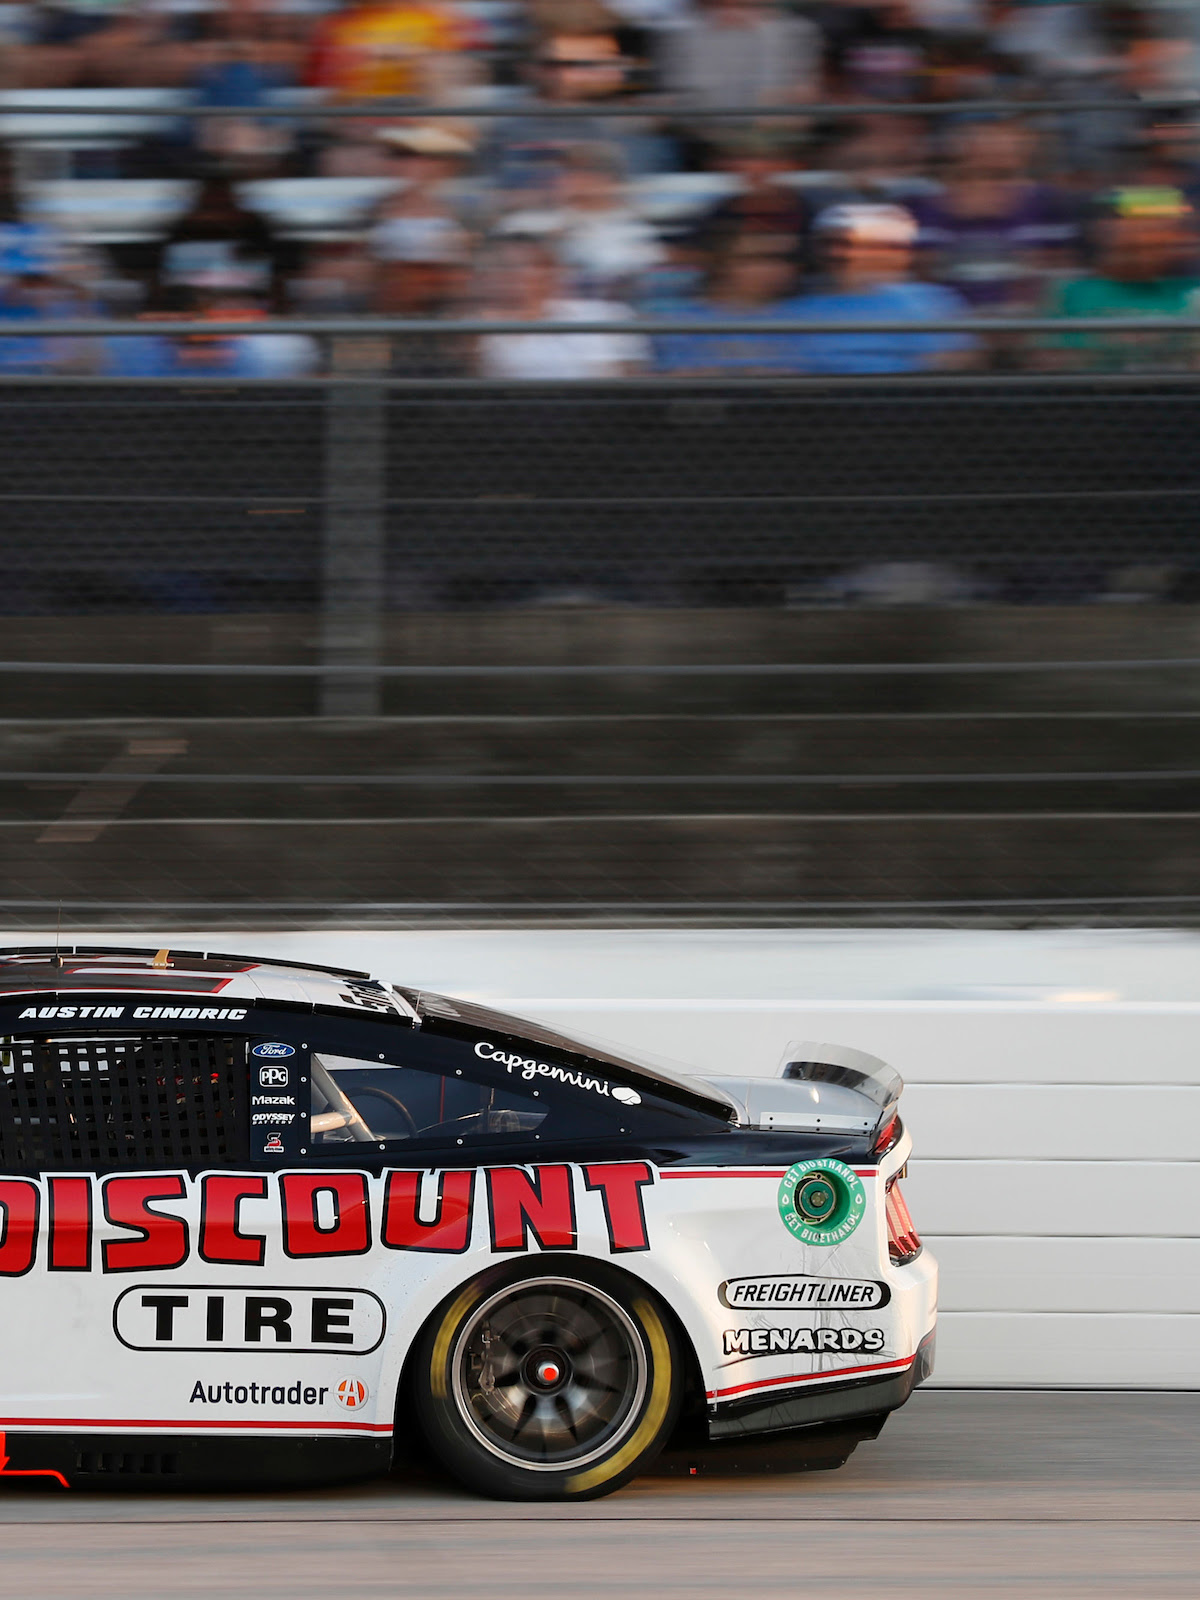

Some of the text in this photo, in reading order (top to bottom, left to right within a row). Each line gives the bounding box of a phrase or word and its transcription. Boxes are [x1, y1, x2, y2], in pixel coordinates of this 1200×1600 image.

[18, 1006, 248, 1021] AUSTIN CINDRIC
[261, 1068, 286, 1084] PPG
[474, 1042, 611, 1097] Capgemini
[252, 1095, 295, 1105] Mazak
[252, 1113, 295, 1121] ODYSSEY
[783, 1168, 800, 1188] GET
[784, 1212, 802, 1231] GET
[732, 1283, 875, 1303] FREIGHTLINER
[141, 1295, 354, 1344] TIRE
[723, 1327, 886, 1355] MENARDS
[189, 1380, 329, 1405] Autotrader
